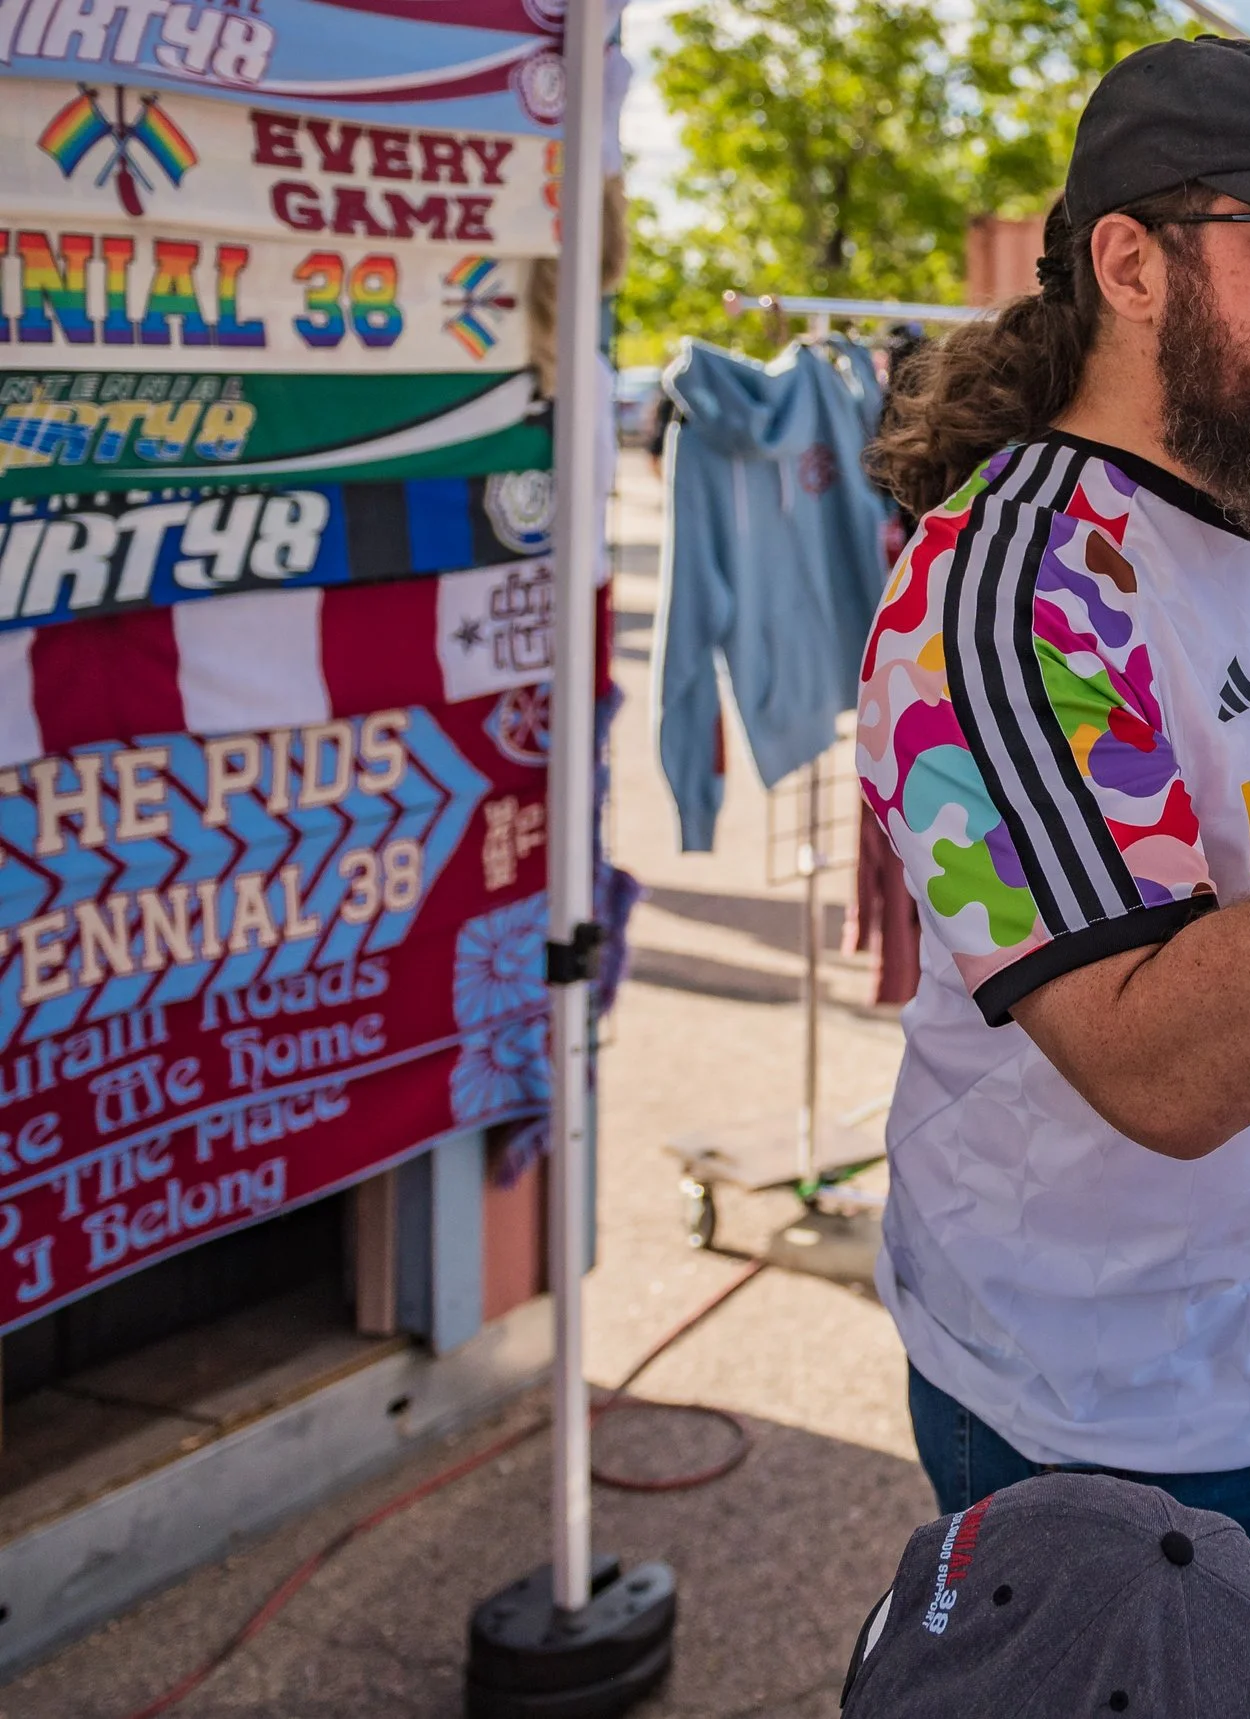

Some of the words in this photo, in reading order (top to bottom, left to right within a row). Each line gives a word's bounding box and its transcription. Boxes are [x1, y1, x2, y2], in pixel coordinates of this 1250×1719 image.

[0, 0, 275, 85] IRTY8
[249, 108, 514, 186] EVERY
[269, 179, 496, 242] GAME
[0, 229, 267, 347] NIAL
[293, 251, 404, 348] 38
[0, 490, 330, 622] IRTY8
[0, 748, 171, 858] HE
[203, 709, 408, 826] PIDS
[0, 864, 319, 1006] ENNIAL
[339, 839, 422, 924] 38
[81, 1157, 288, 1273] Belong
[921, 1563, 949, 1630] SUPPORT
[929, 1588, 958, 1636] 38
